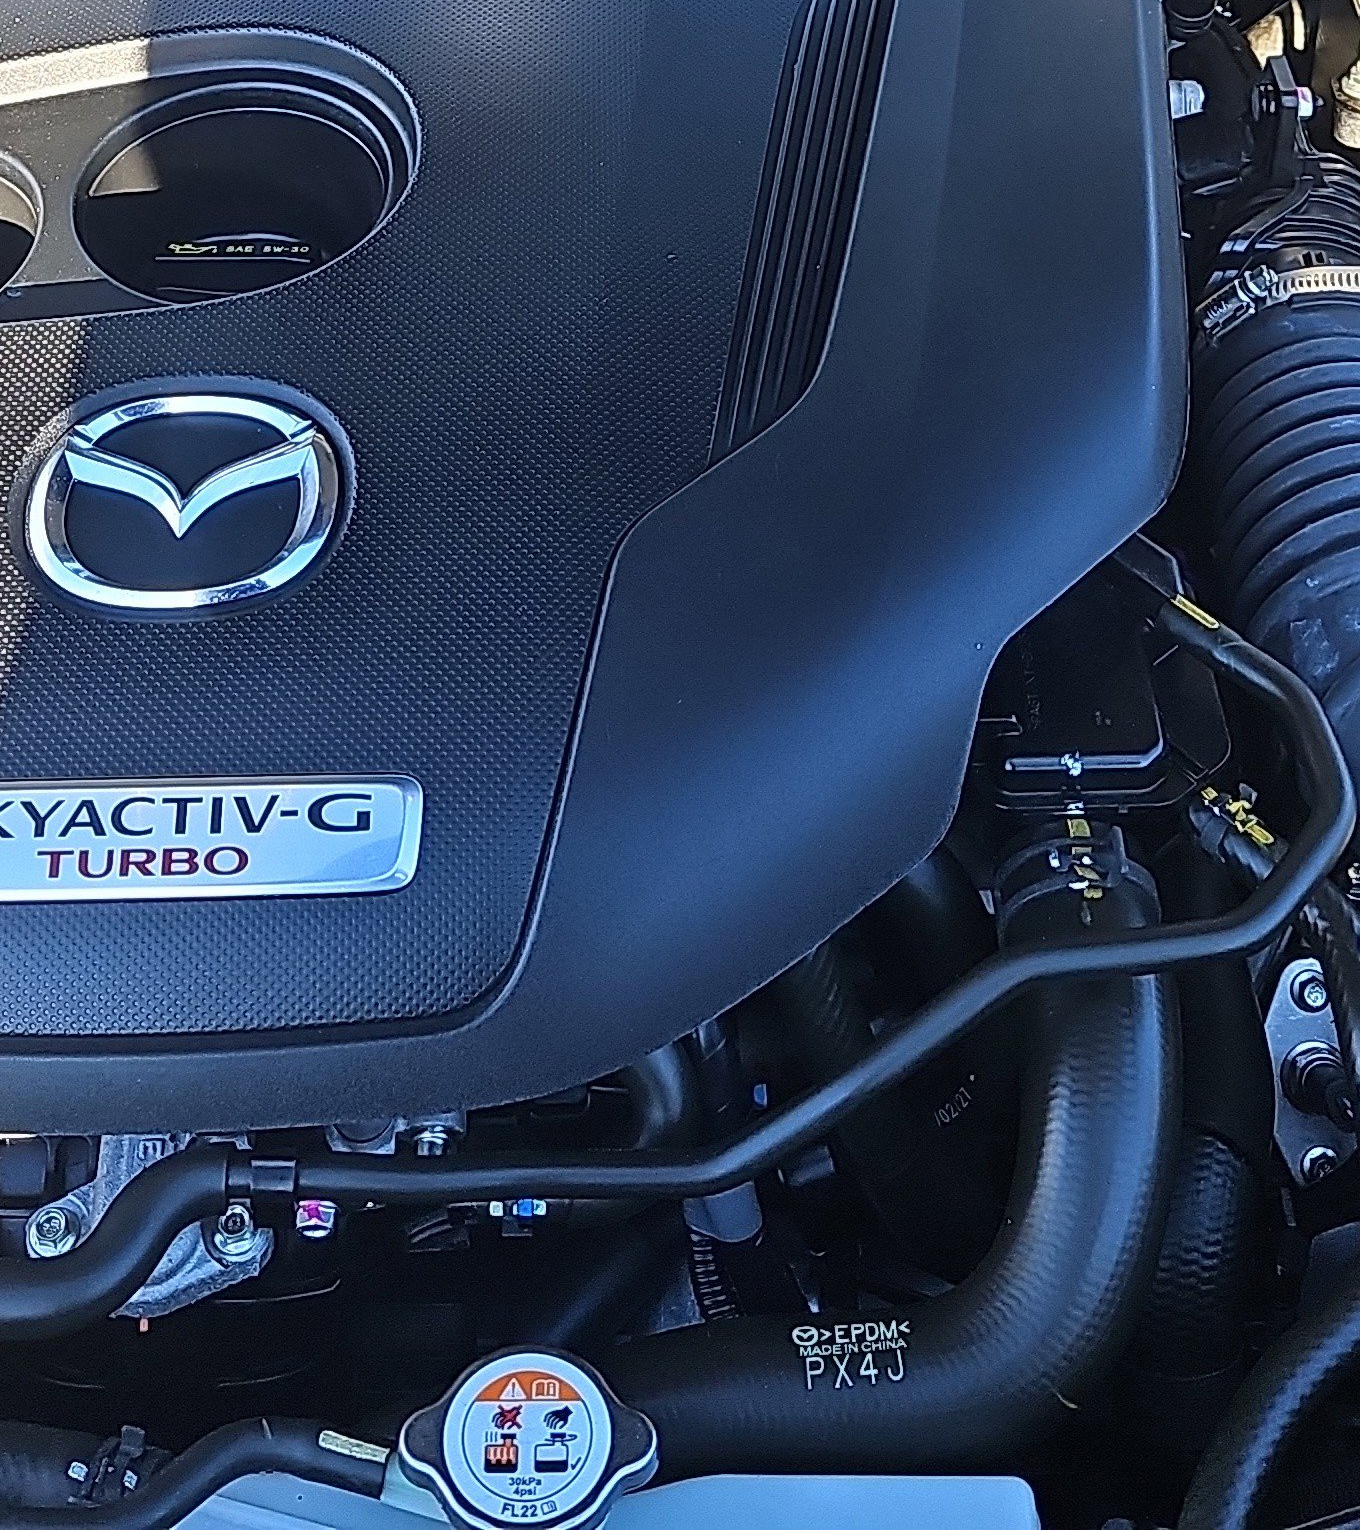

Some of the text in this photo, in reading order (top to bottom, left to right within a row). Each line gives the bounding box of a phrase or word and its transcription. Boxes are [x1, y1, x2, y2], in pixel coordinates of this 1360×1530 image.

[225, 245, 309, 253] SAE 5W-30
[38, 846, 248, 879] TURBO
[799, 1337, 908, 1357] MADE IN CHINA
[805, 1349, 904, 1390] PX4J
[508, 1476, 543, 1488] 30kPa
[512, 1487, 537, 1497] 4psi
[500, 1502, 538, 1518] FL22
